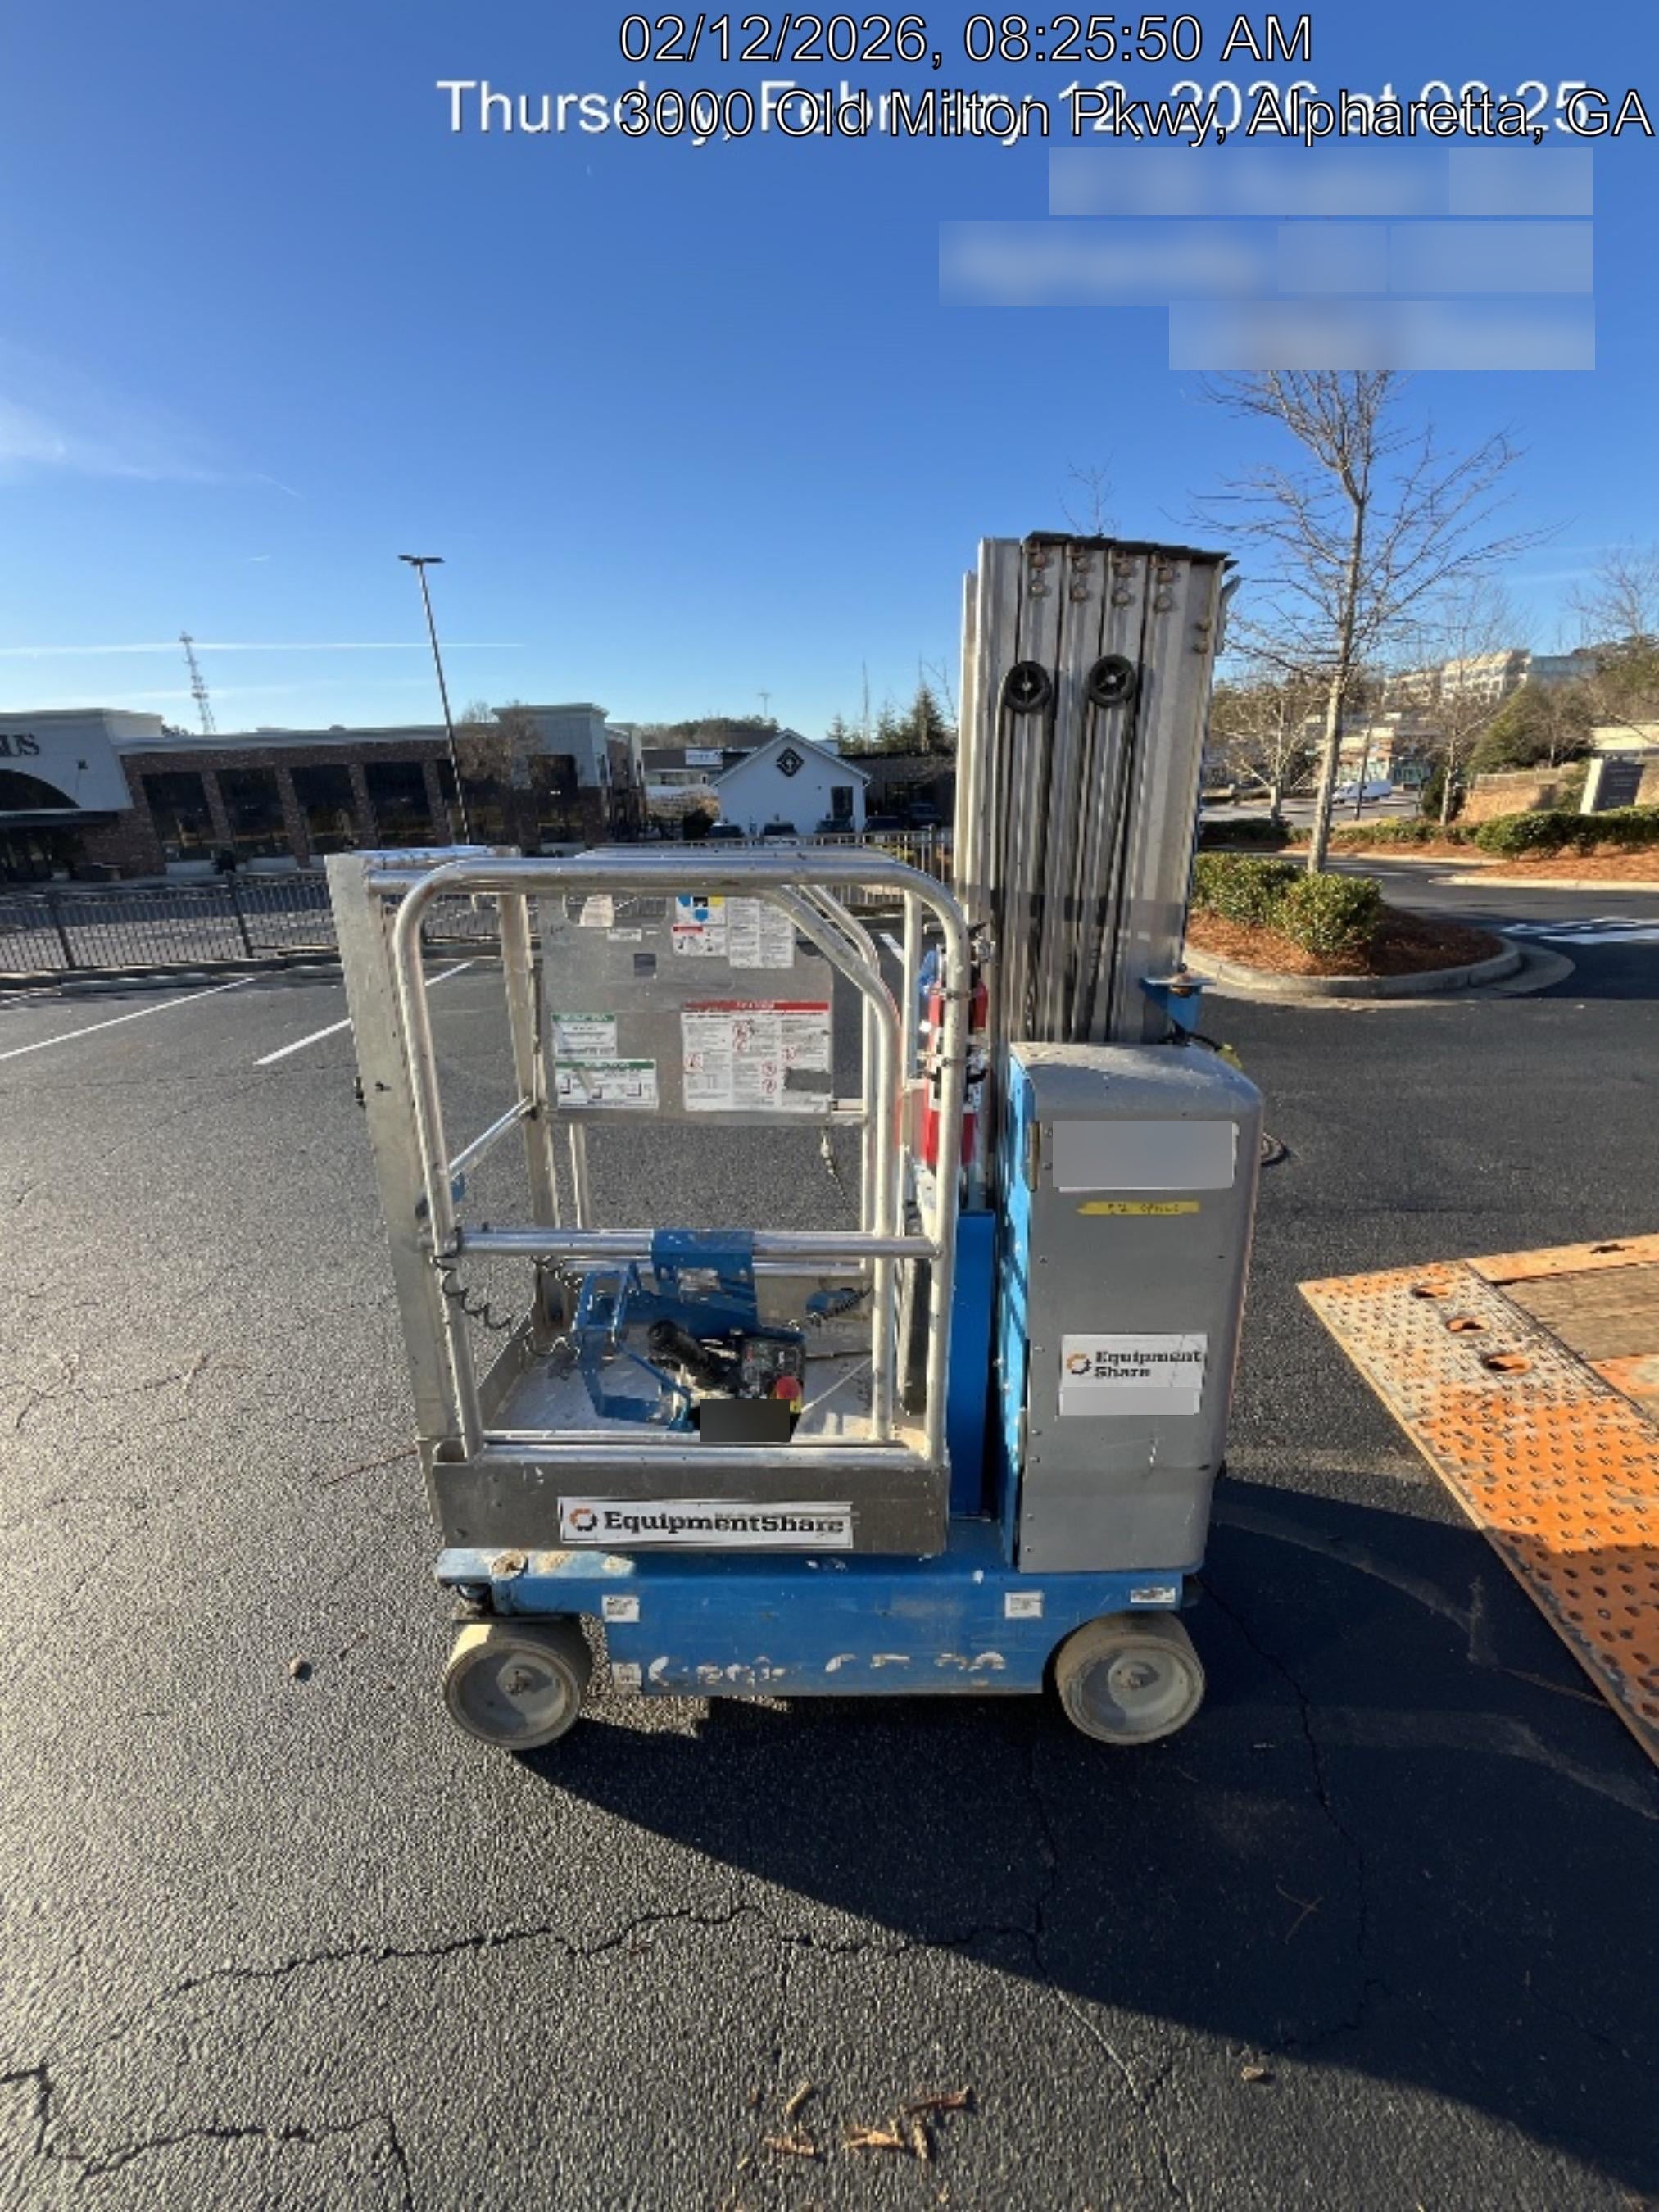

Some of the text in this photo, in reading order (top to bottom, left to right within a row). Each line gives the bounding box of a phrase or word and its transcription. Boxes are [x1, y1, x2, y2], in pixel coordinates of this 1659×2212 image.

[1095, 1350, 1202, 1365] Equipment
[1095, 1365, 1151, 1378] Share
[603, 1511, 845, 1534] EquipmentShare
